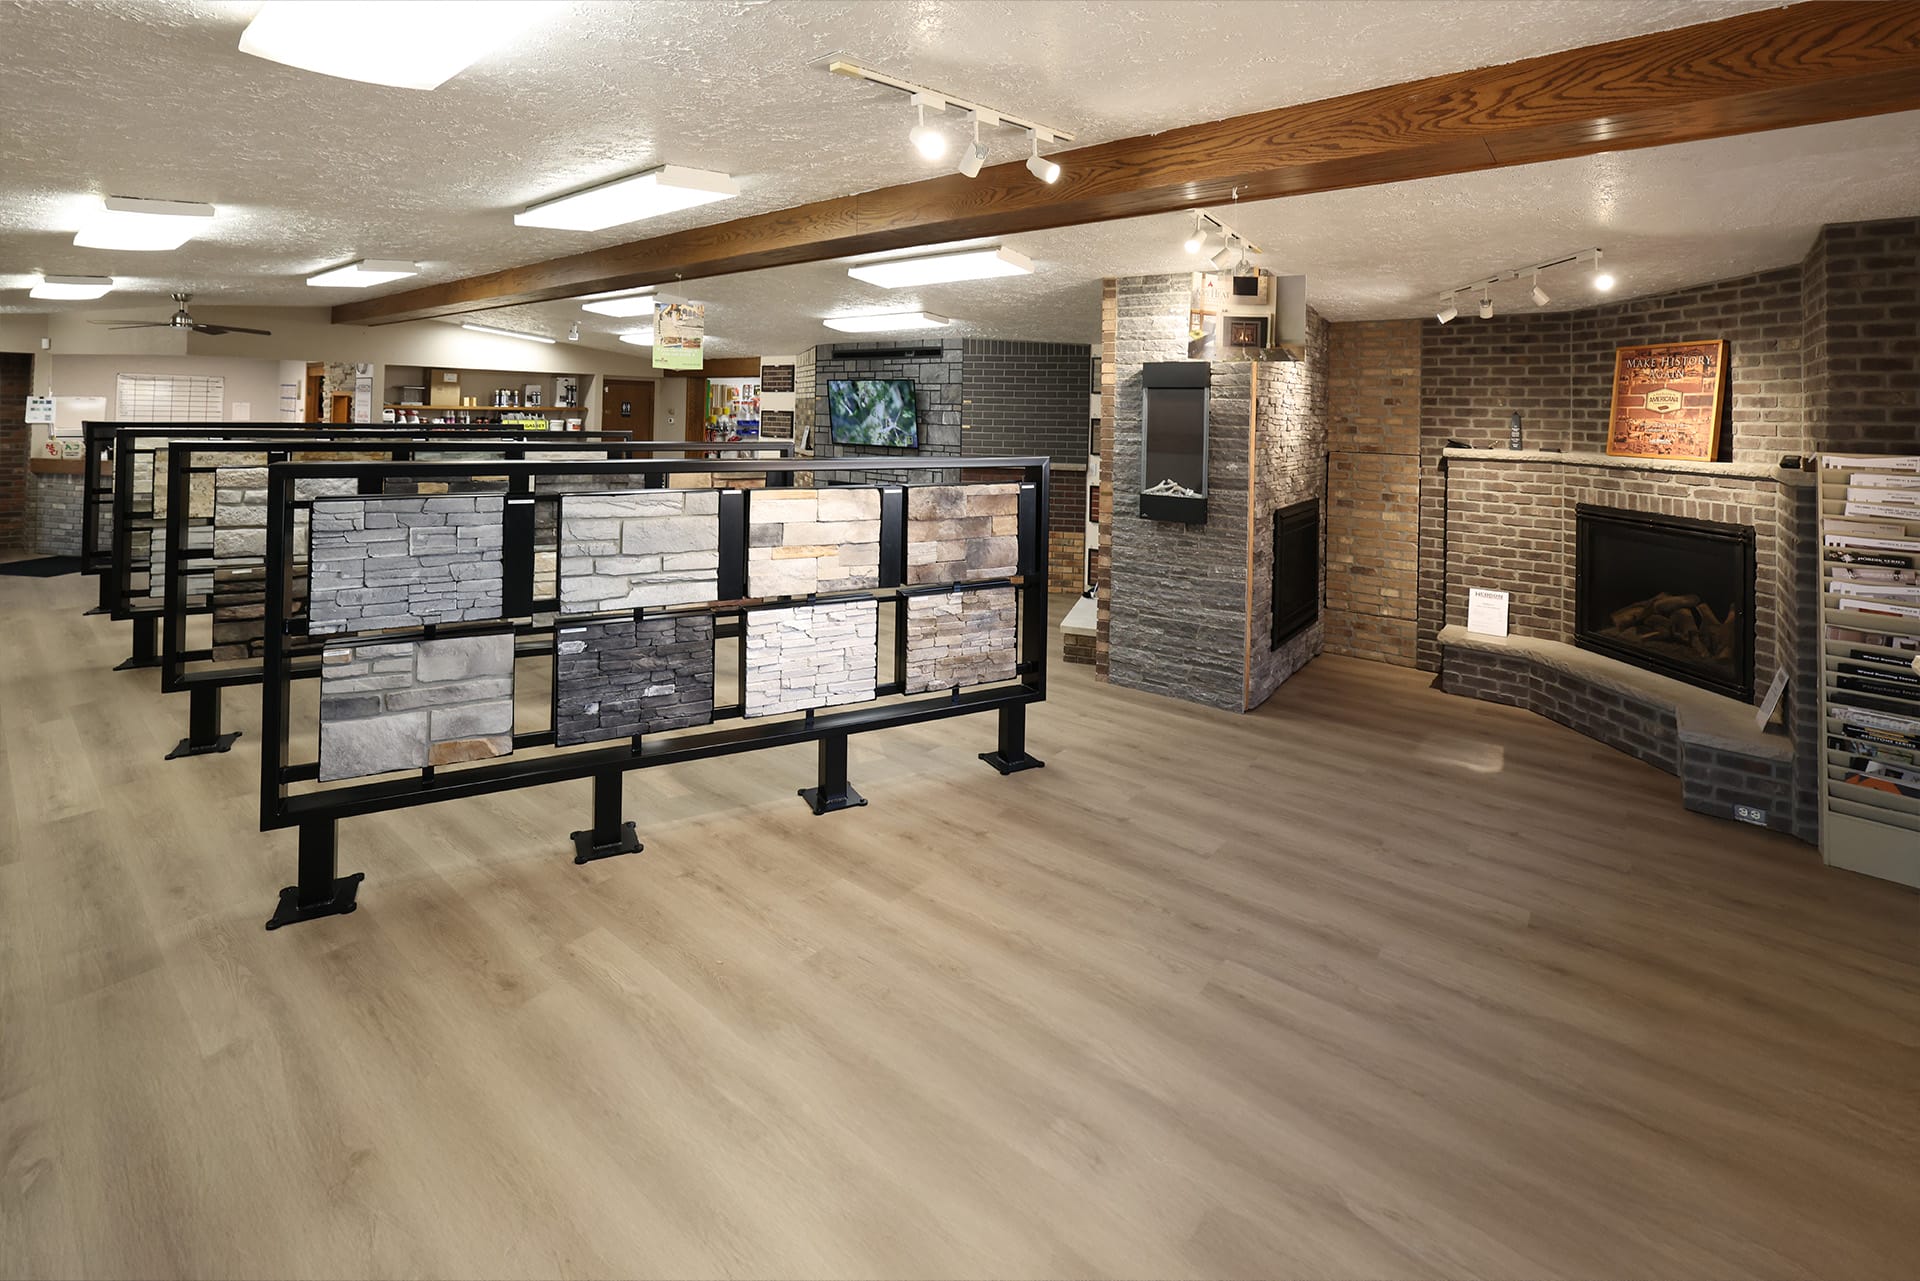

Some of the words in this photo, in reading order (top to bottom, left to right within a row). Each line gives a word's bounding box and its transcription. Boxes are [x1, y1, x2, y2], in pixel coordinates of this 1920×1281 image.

[1627, 358, 1656, 368] MAKE
[1661, 355, 1712, 367] HISTORY
[1649, 369, 1685, 379] AGAIN
